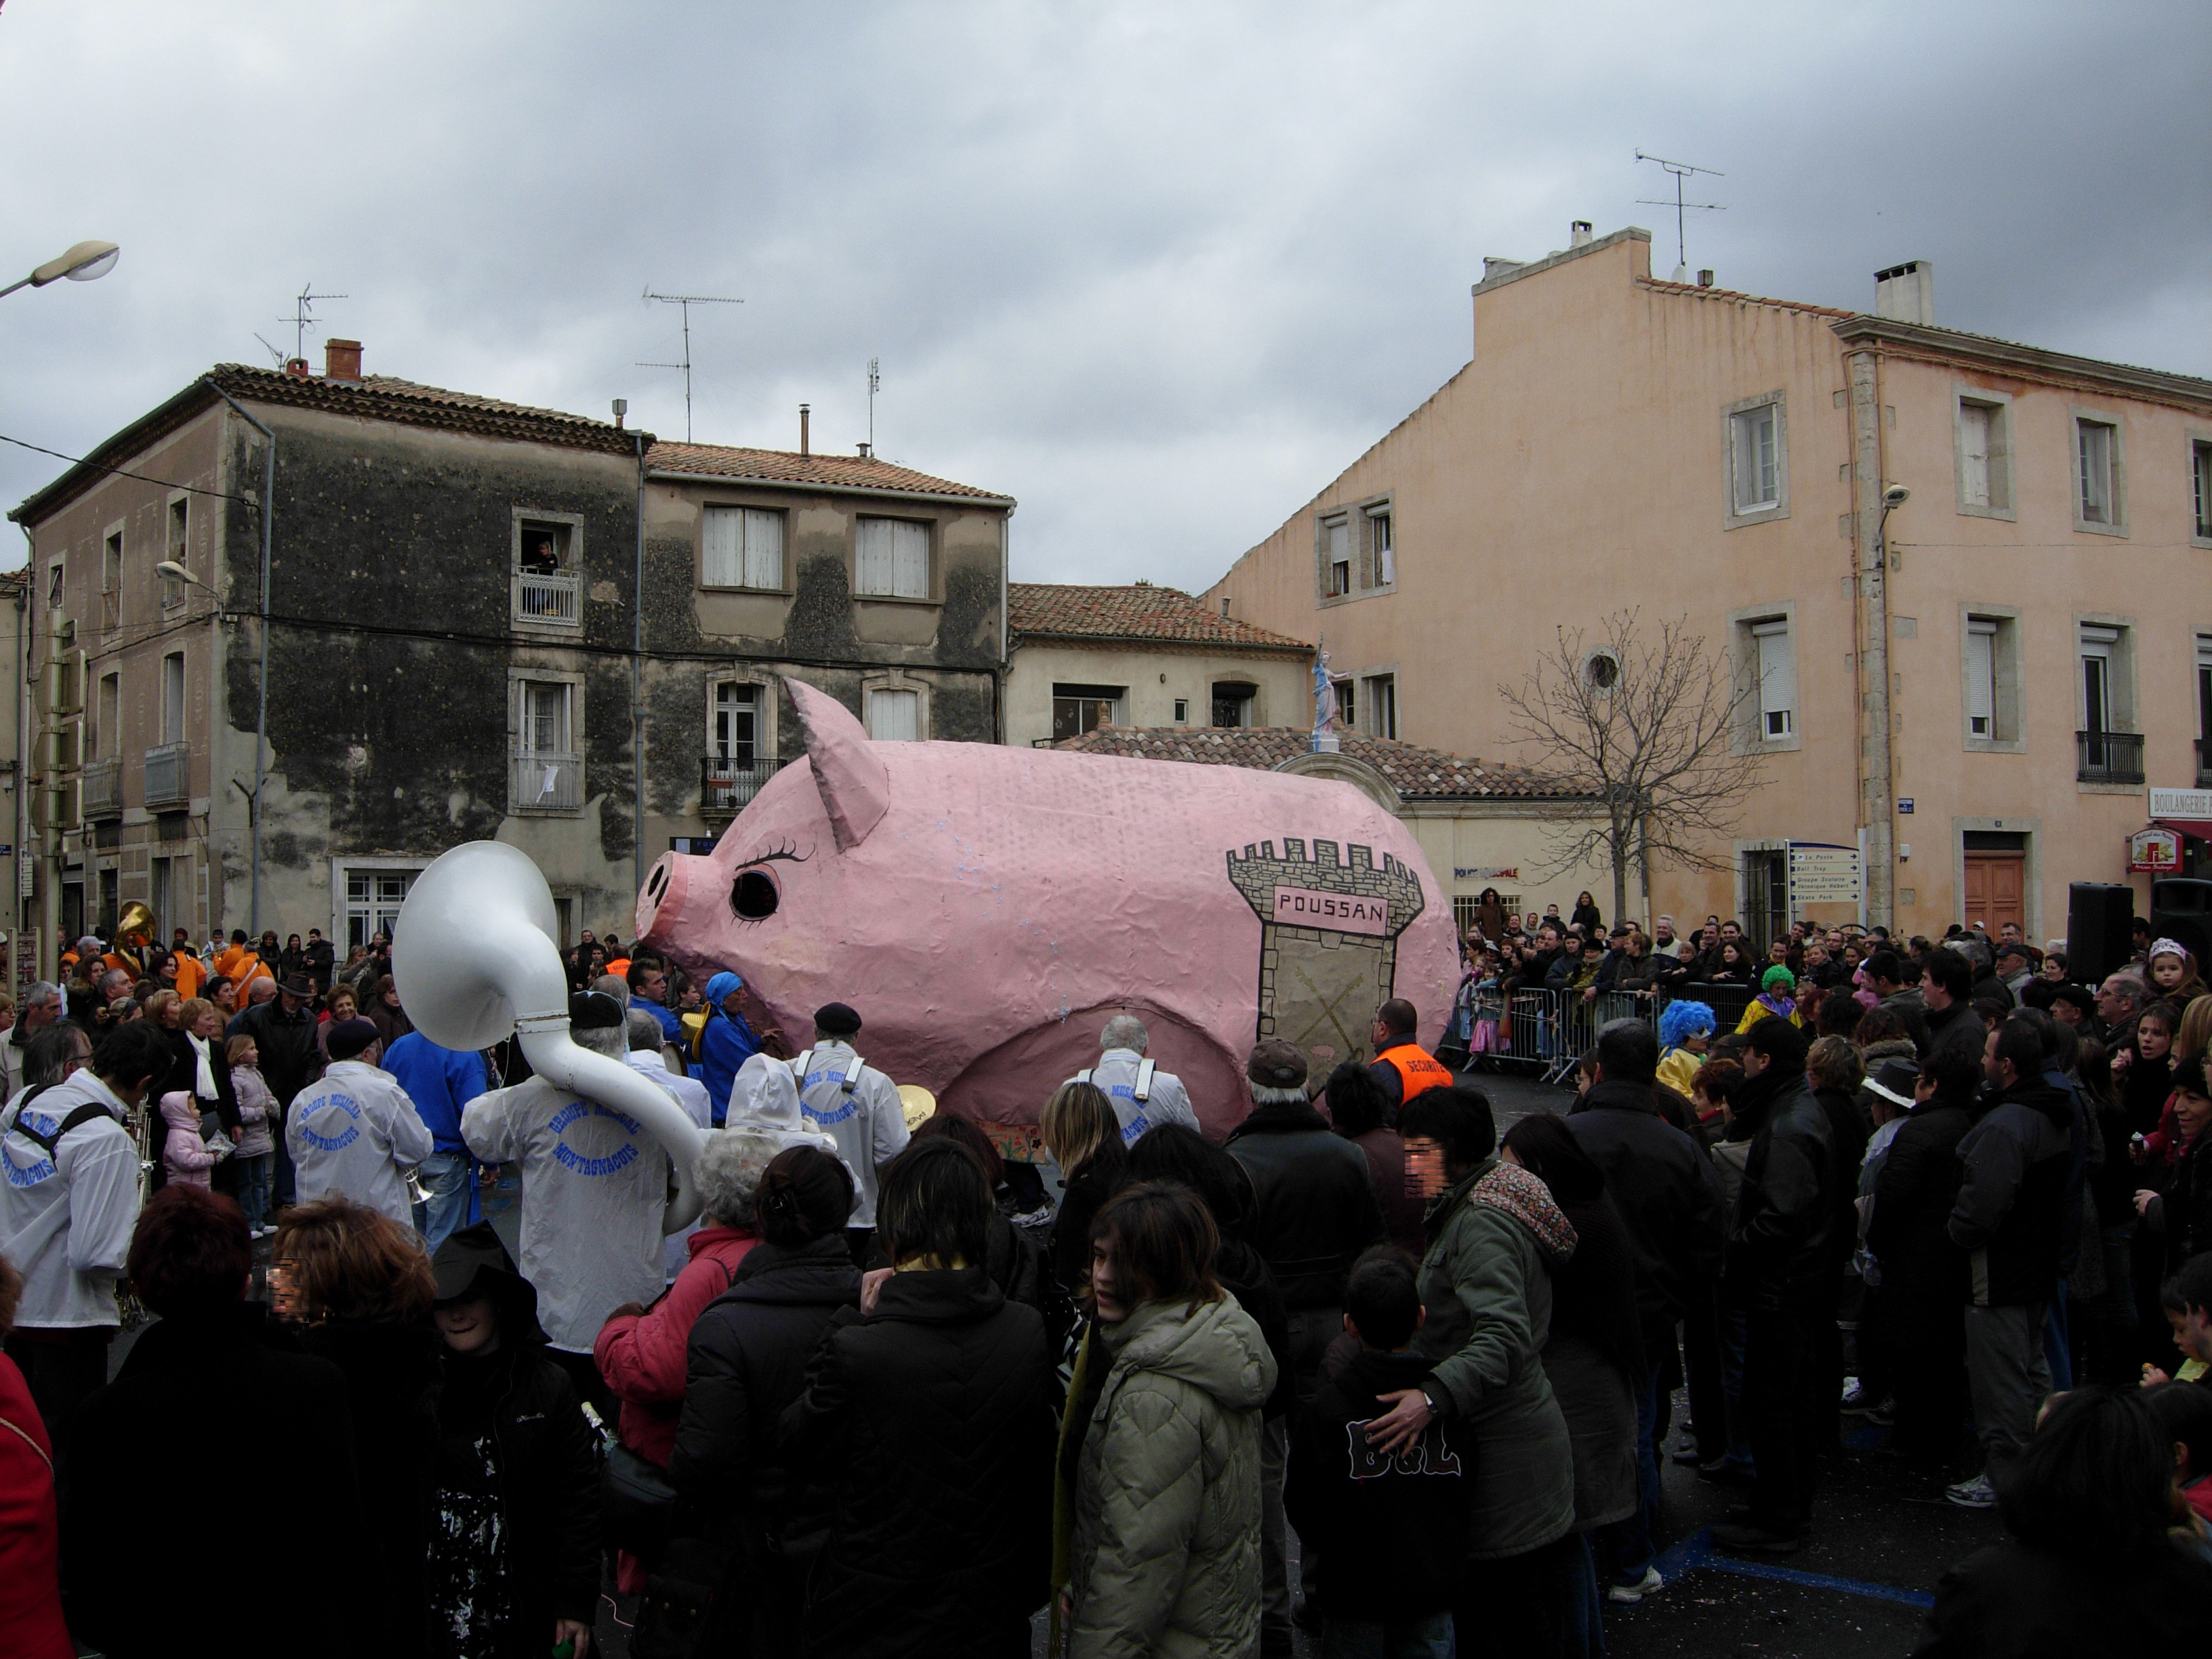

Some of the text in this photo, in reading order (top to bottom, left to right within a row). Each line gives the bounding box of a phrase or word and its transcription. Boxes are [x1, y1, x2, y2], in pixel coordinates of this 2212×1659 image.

[2154, 794, 2207, 813] BOULANGERIE
[1454, 867, 1518, 878] POLICE MUNICIPALE
[1279, 894, 1382, 922] POUSSAN
[300, 1093, 361, 1121] GROUPE MUSICAL
[548, 1100, 589, 1134] GROUPE
[302, 1126, 361, 1151] MONTAGNACOIS
[552, 1141, 639, 1176] MONTAGNACOIS
